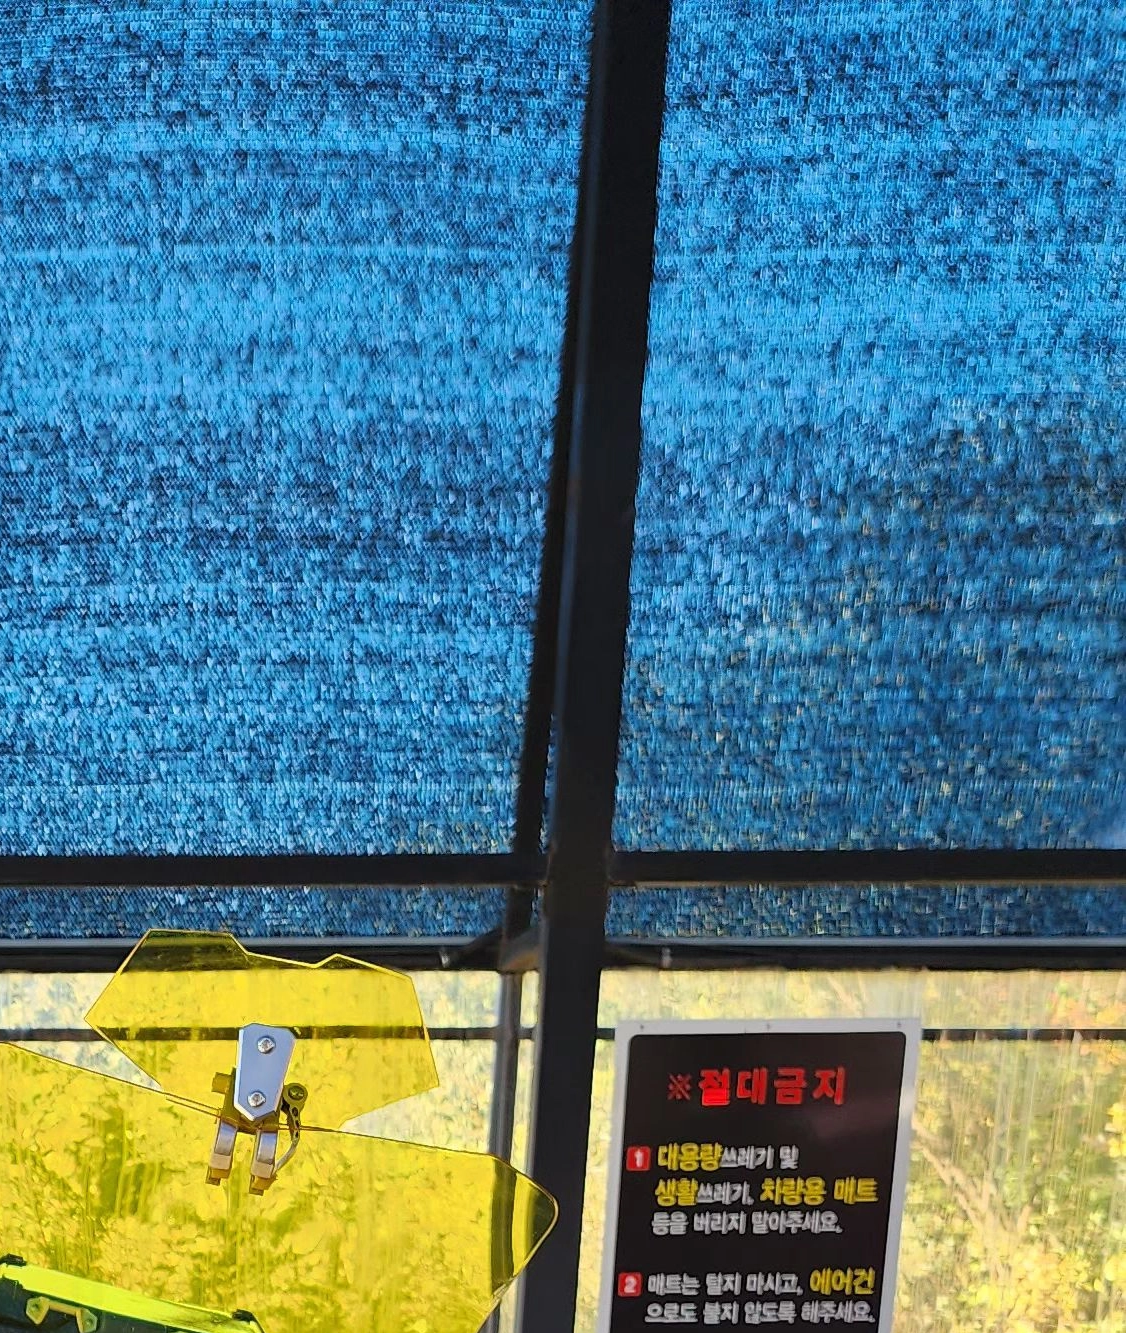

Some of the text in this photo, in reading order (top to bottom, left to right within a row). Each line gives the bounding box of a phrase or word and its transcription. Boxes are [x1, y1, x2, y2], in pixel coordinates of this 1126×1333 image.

[699, 1067, 845, 1106] 절대금지
[658, 1143, 774, 1171] 대용량쓰레기
[780, 1146, 798, 1169] 및
[760, 1177, 826, 1205] 차량용
[834, 1177, 878, 1204] 매트
[652, 1212, 688, 1235] 등을
[694, 1211, 746, 1234] 버리지
[648, 1274, 700, 1295] 매트는
[810, 1268, 875, 1295] 에어건
[645, 1303, 698, 1323] 으로도
[703, 1302, 739, 1324] 불지
